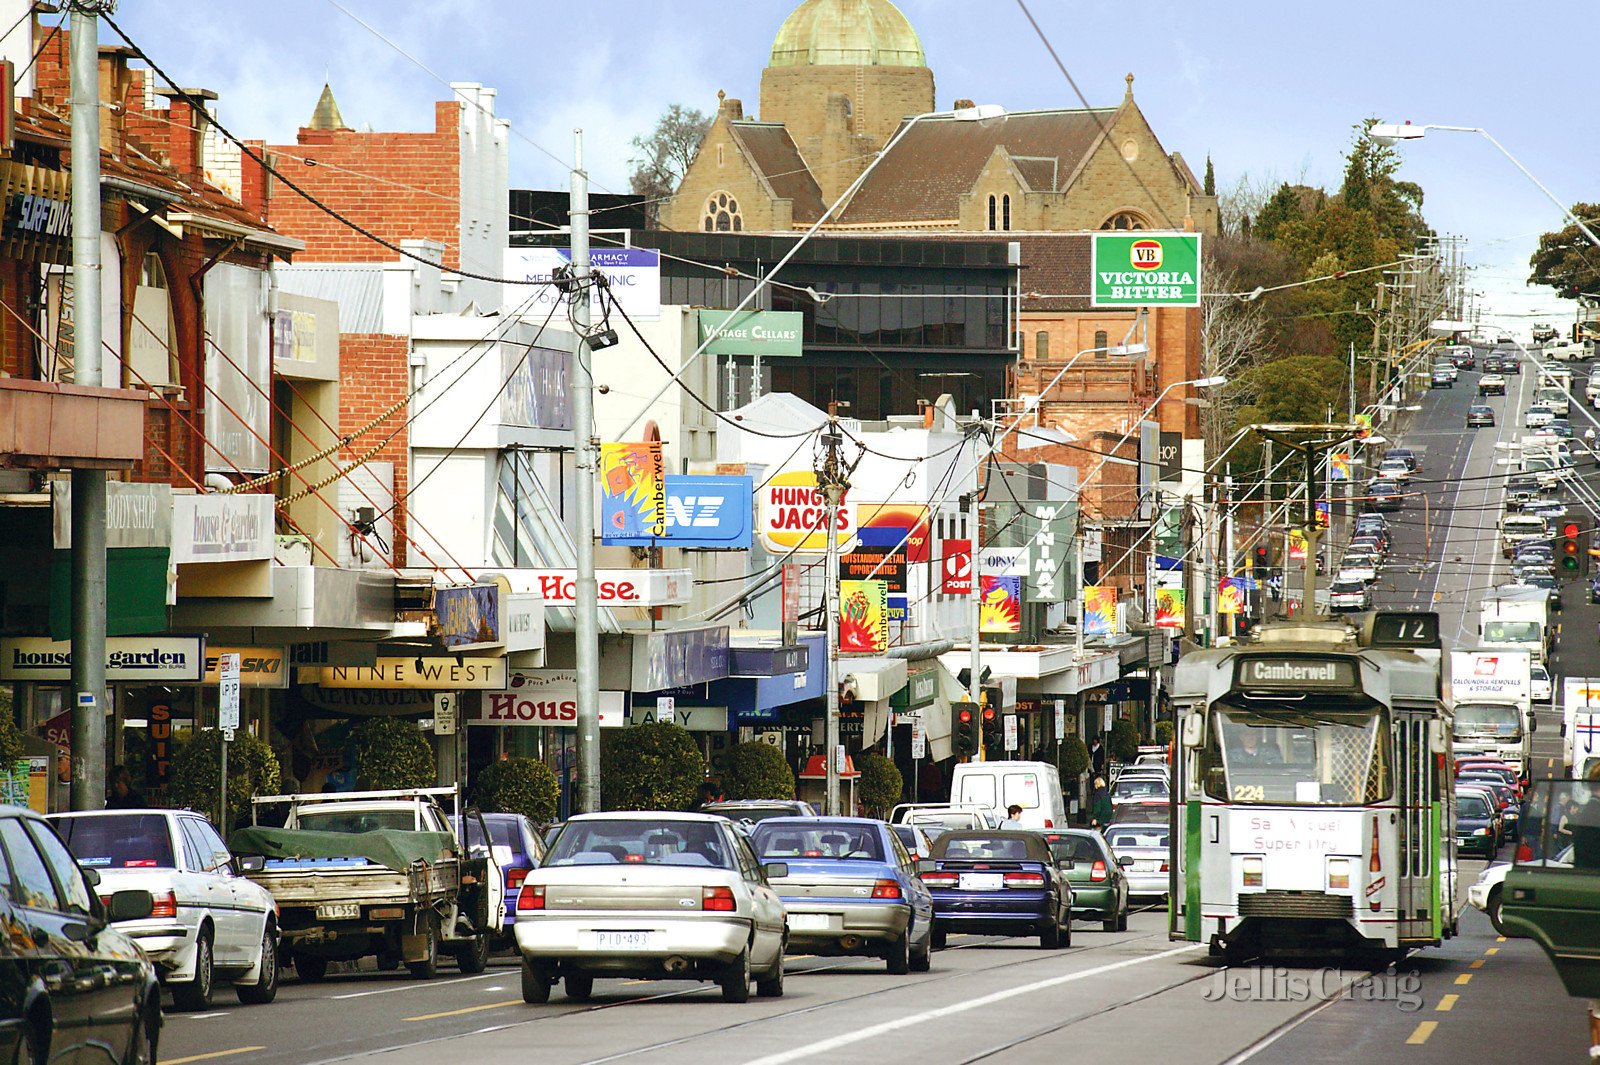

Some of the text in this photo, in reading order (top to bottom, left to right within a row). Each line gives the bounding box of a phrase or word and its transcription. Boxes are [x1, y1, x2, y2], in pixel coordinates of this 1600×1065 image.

[18, 194, 49, 233] SURF
[1137, 249, 1156, 261] VB
[1099, 272, 1194, 285] VICTORIA
[1111, 286, 1183, 299] BITTER
[1159, 445, 1177, 460] HOP
[771, 488, 849, 506] HUNGY
[107, 494, 157, 529] BODY SHOP
[666, 496, 725, 527] NZ
[771, 508, 849, 530] JACKS
[841, 553, 884, 564] OUTSTANDING
[1034, 506, 1057, 599] MINIMAX
[538, 575, 640, 600] Hose.
[1398, 620, 1425, 639] 72
[109, 648, 186, 669] garden
[333, 664, 493, 682] NINE WEST
[551, 673, 577, 683] natura
[1254, 662, 1336, 680] Camberwell
[489, 693, 604, 720] Hous.
[1015, 701, 1034, 710] OST
[1234, 785, 1264, 800] 224
[1254, 837, 1301, 851] Super
